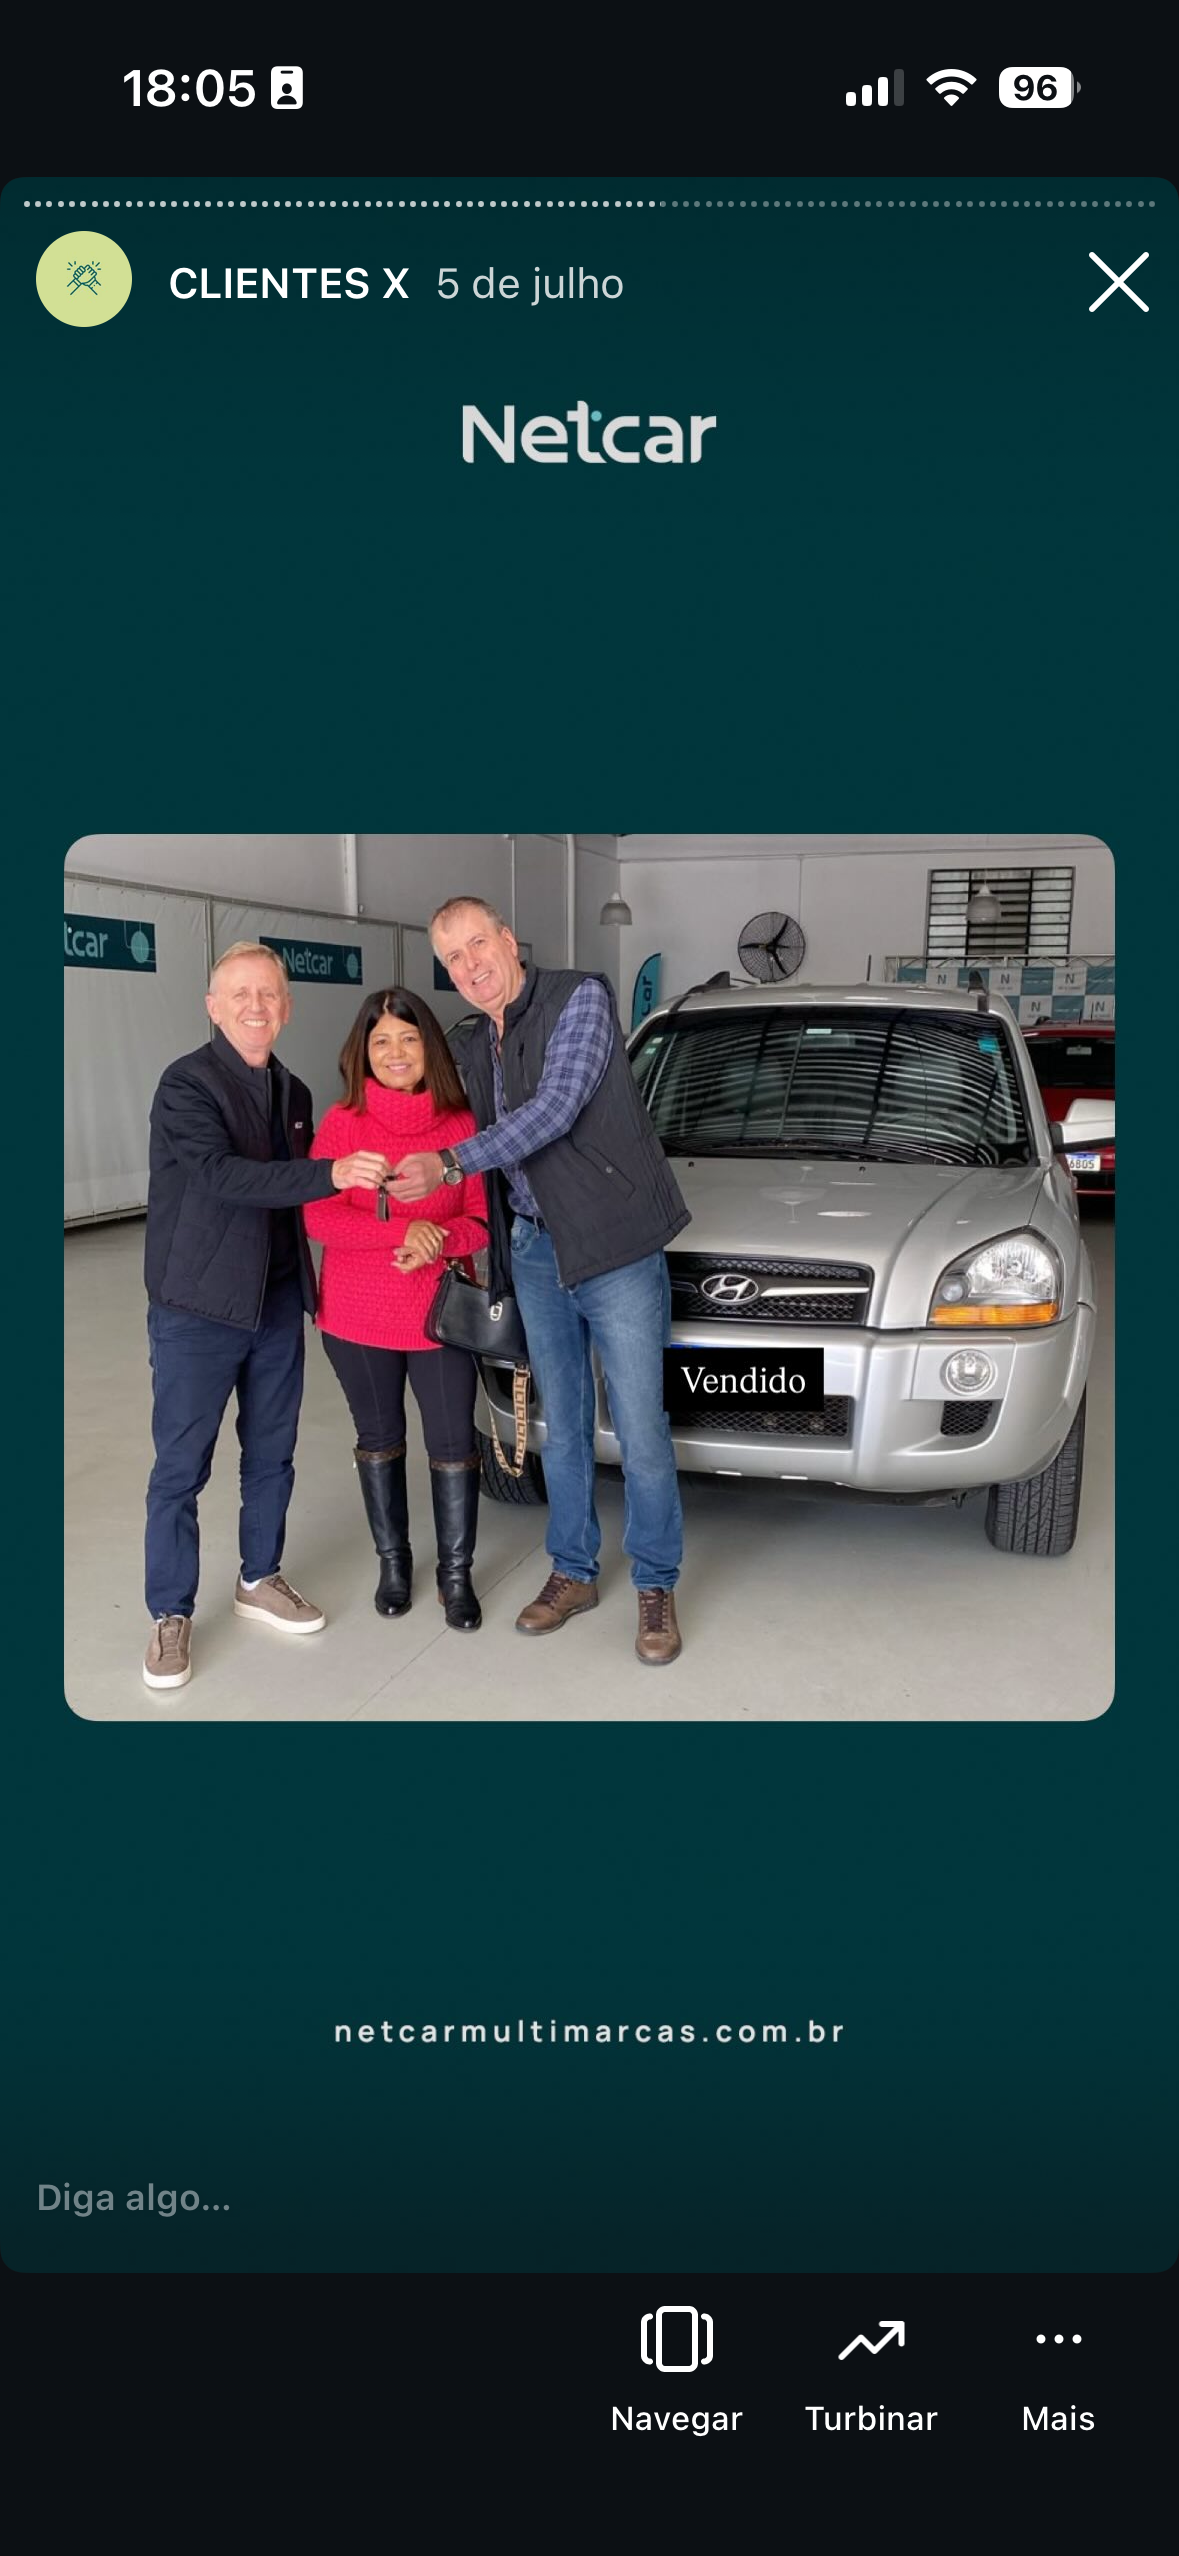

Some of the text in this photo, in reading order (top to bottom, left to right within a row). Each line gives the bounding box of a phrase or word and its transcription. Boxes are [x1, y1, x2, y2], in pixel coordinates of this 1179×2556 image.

[123, 69, 256, 108] 18:05
[1013, 74, 1058, 102] 96
[169, 266, 624, 307] CLIENTES X 5 de julho
[282, 946, 334, 976] Netcar
[1001, 973, 1010, 984] N
[1065, 973, 1075, 984] N
[37, 2181, 231, 2218] Diga algo...
[612, 2406, 744, 2437] Navegar
[804, 2404, 939, 2431] Turbinar
[1022, 2404, 1096, 2431] Mais
